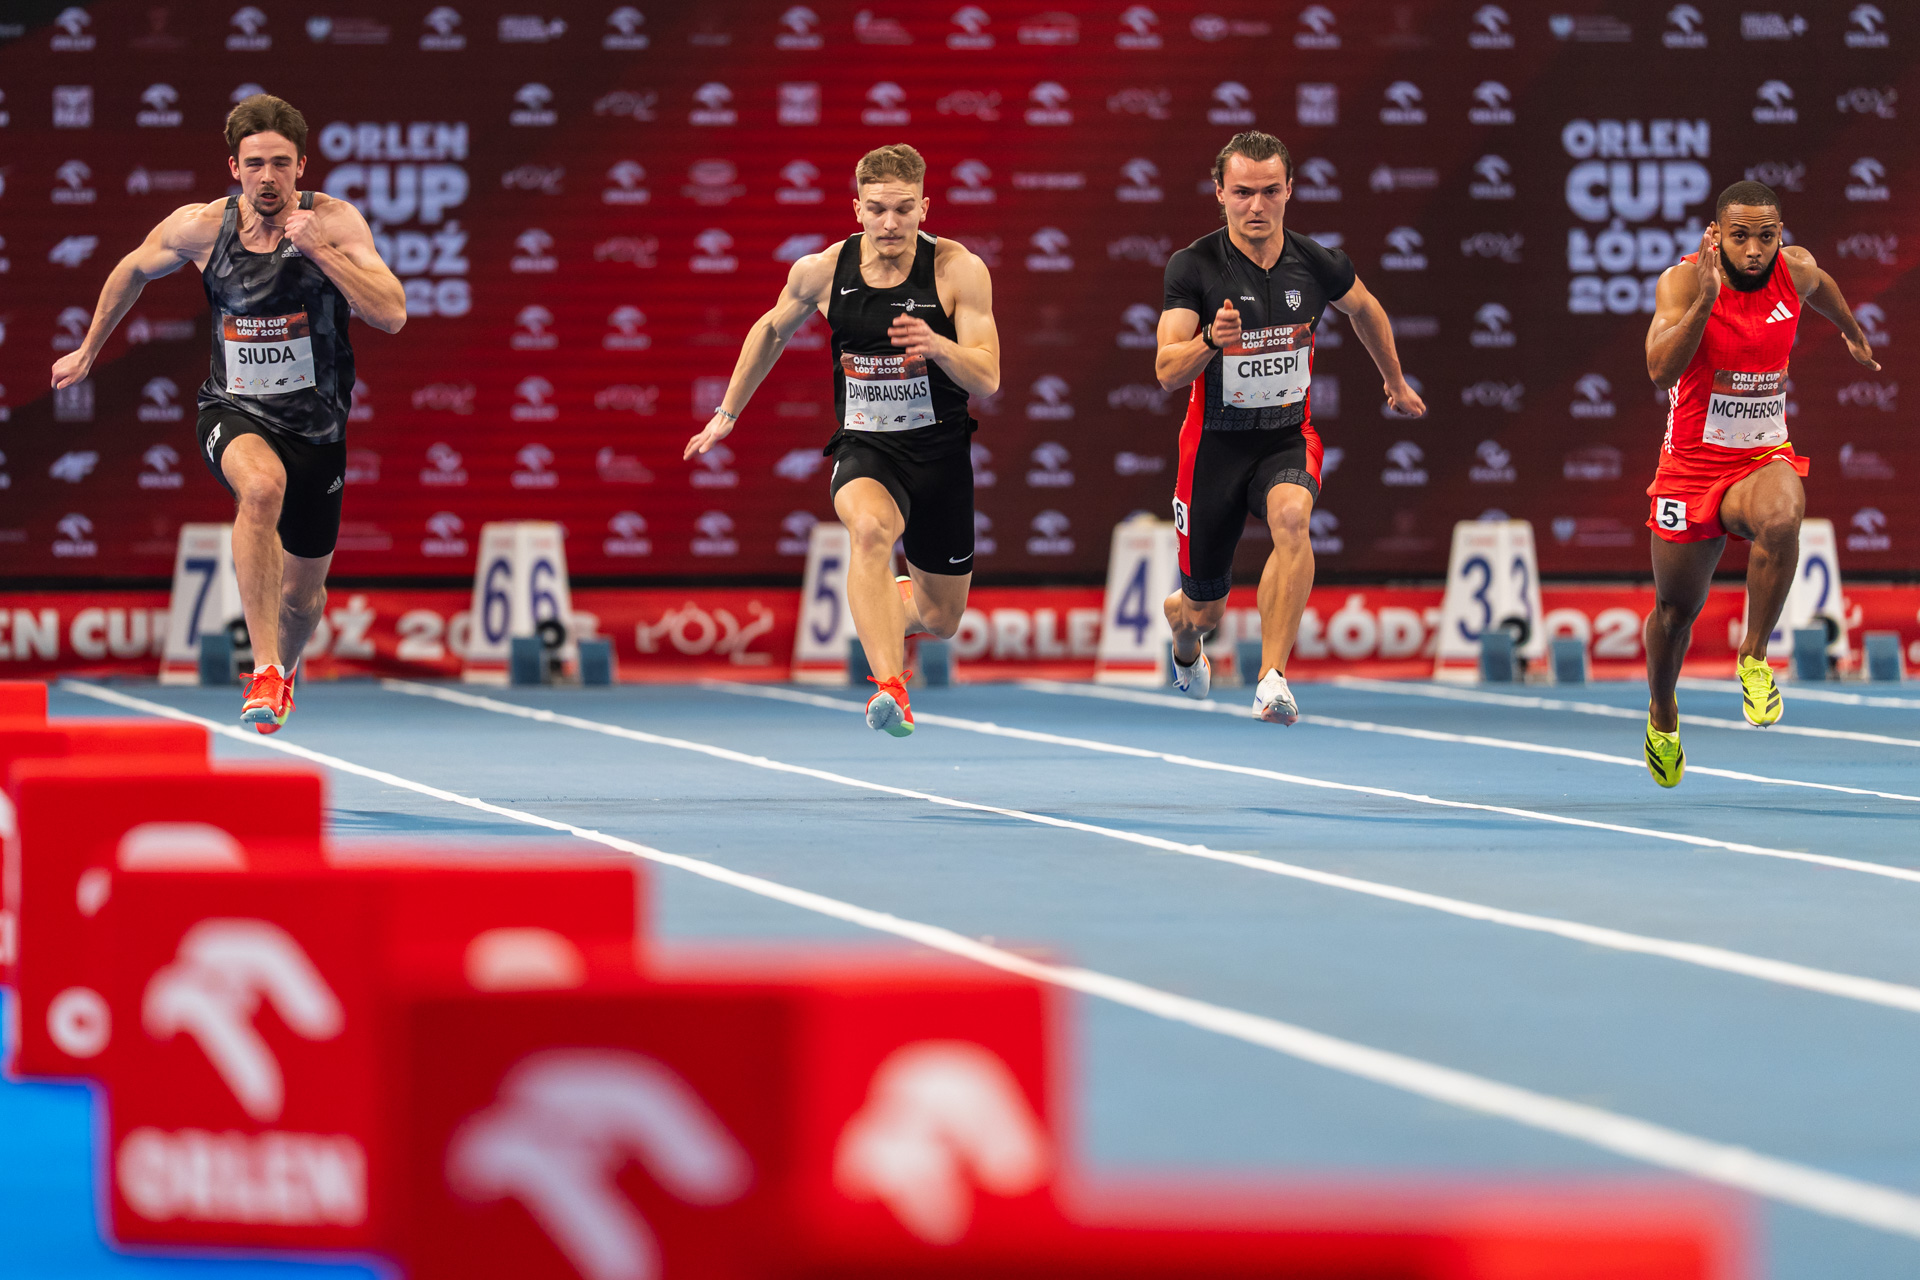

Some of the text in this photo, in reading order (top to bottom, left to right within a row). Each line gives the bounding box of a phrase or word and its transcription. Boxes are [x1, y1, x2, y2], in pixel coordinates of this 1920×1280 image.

[320, 122, 469, 161] ORLEN
[1562, 119, 1710, 158] ORLEN
[323, 163, 470, 225] CUP
[1565, 161, 1711, 222] CUP
[235, 317, 287, 328] ORLEN CUP
[260, 327, 289, 337] 2026
[1241, 326, 1294, 341] ORLEN CUP
[238, 345, 296, 365] SIUDA
[1266, 337, 1295, 347] 2026
[853, 356, 904, 366] ORLEN CUP
[1237, 350, 1300, 379] CRESPÍ
[848, 381, 928, 402] DAMBRAUSKAS
[1732, 372, 1781, 383] ORLEN CUP
[1757, 383, 1779, 391] 2026
[1711, 398, 1785, 419] MCPHERSON
[1175, 502, 1184, 530] 6
[1661, 501, 1679, 528] 5
[184, 556, 218, 648] 7
[482, 556, 513, 647] 6
[527, 556, 560, 630] 6
[811, 556, 842, 645] 5
[1114, 556, 1154, 647] 4
[1458, 554, 1493, 642] 3
